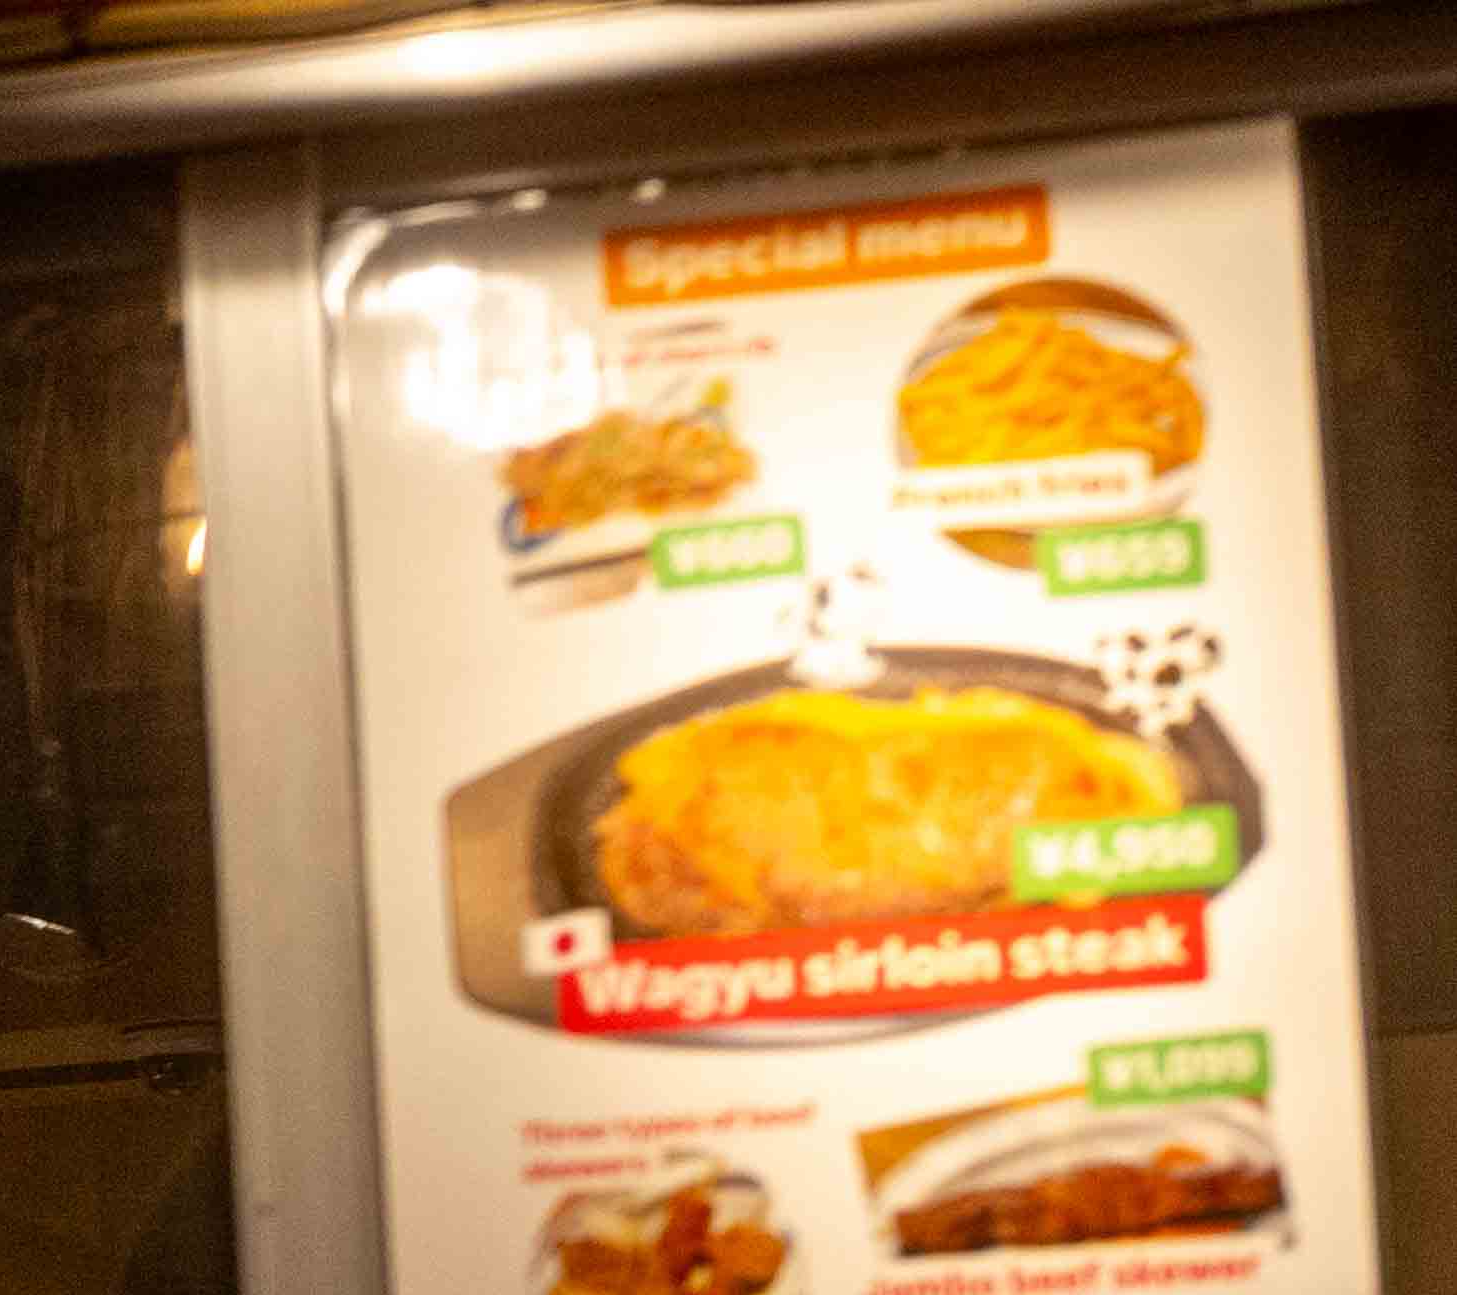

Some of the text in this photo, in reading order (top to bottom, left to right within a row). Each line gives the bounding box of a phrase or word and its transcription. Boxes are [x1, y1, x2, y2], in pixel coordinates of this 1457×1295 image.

[623, 208, 1028, 294] Special menu
[1027, 819, 1218, 882] ¥4,950
[572, 914, 1188, 1018] Wagyu sirloin steak
[1008, 1262, 1099, 1295] beef
[1112, 1255, 1261, 1289] skewer
